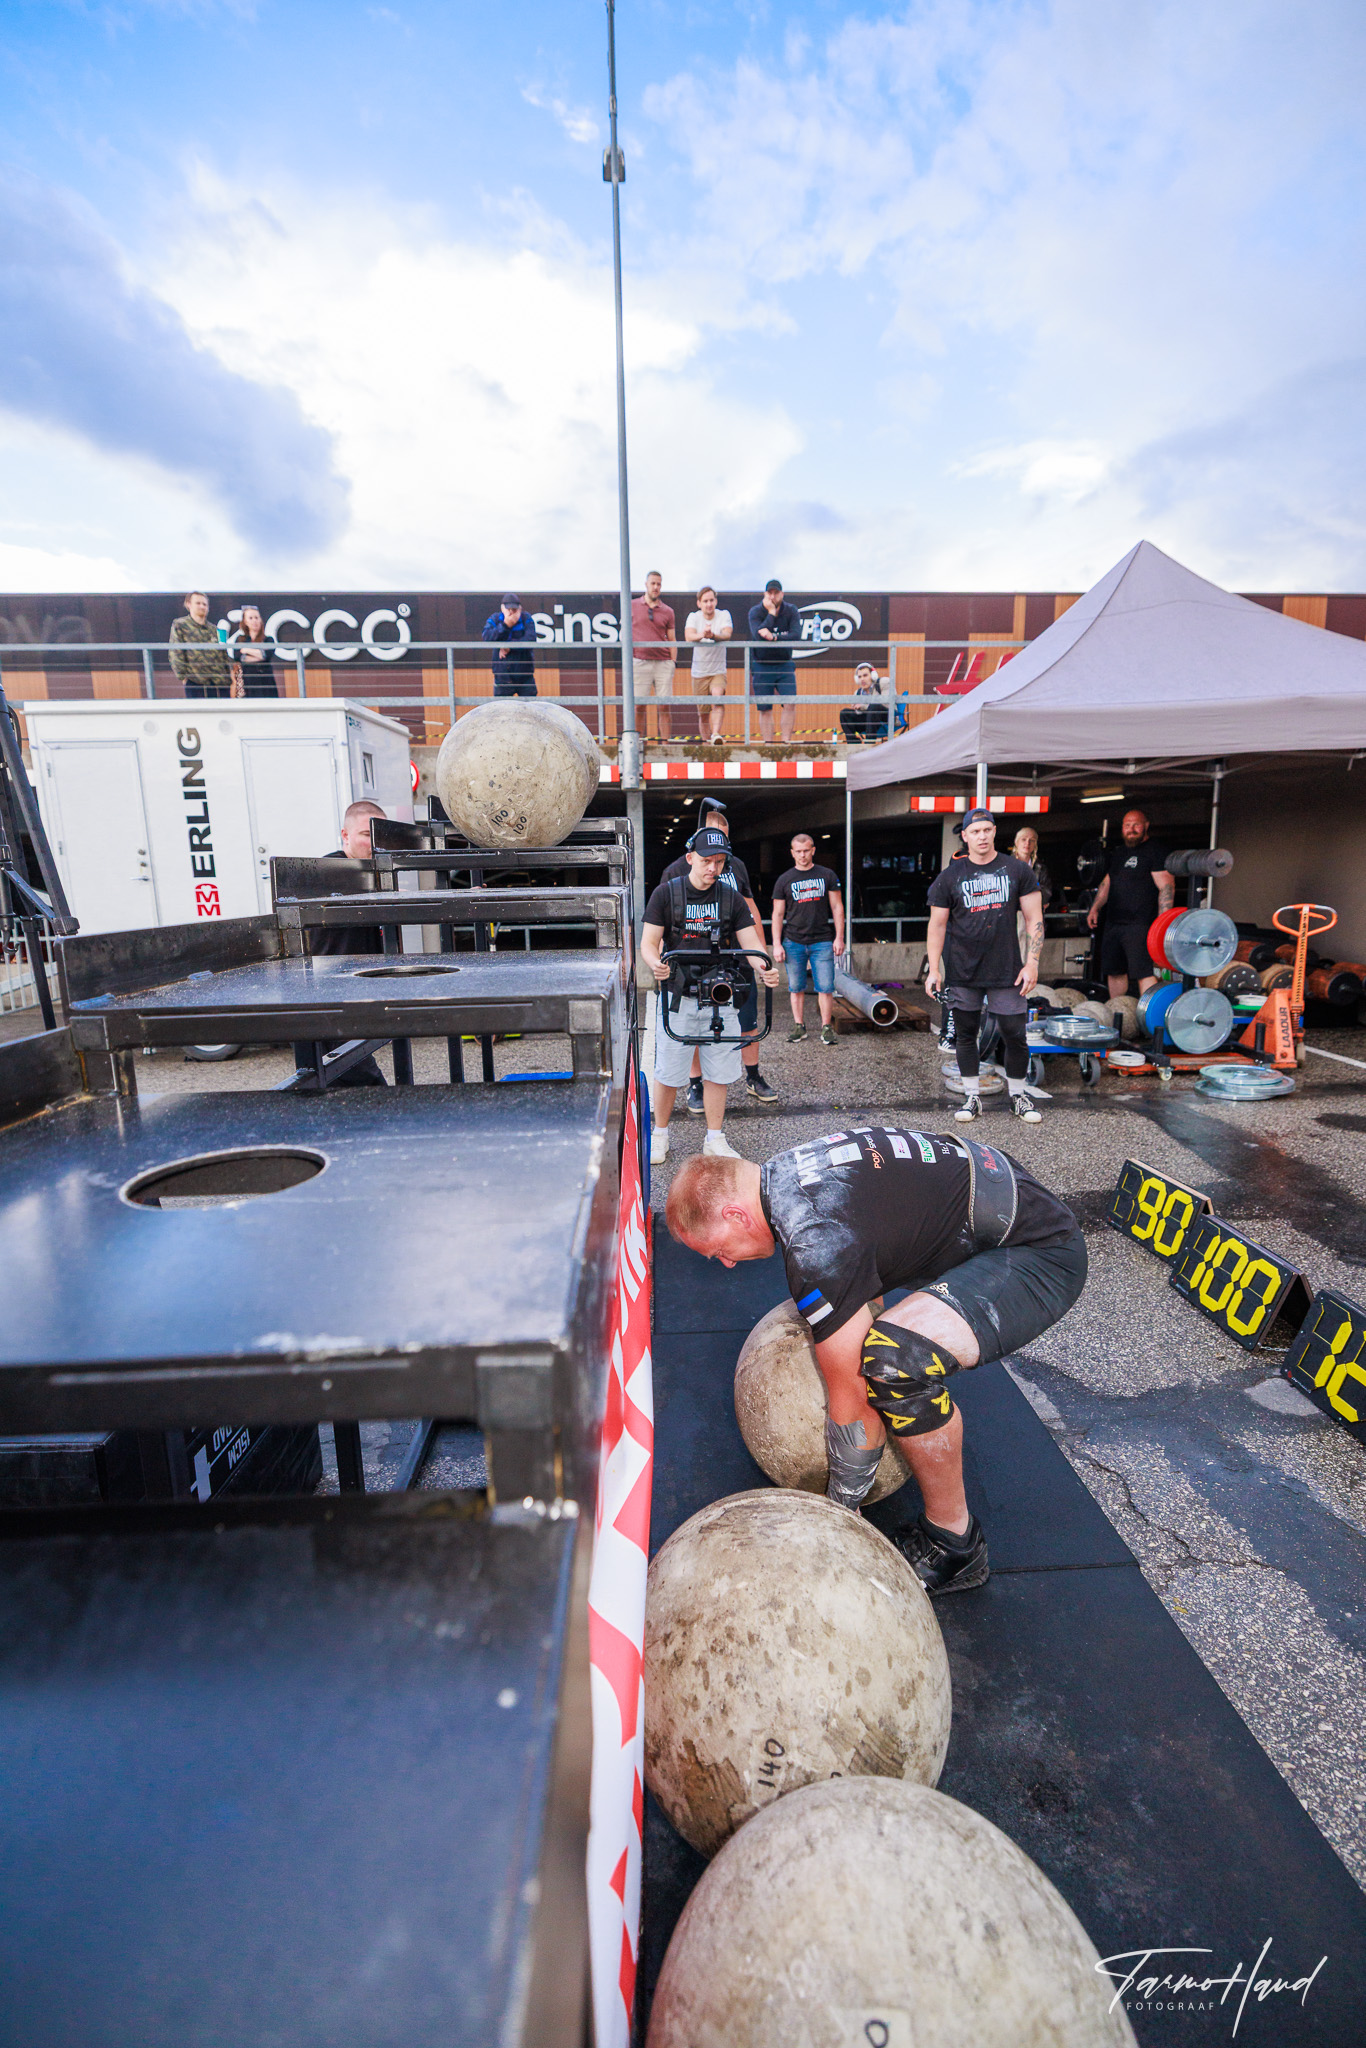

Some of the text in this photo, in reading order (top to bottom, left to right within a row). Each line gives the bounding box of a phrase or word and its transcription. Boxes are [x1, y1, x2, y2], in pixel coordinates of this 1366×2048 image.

[531, 604, 622, 643] sins
[176, 727, 216, 878] ERLING
[491, 810, 508, 828] 100
[513, 816, 527, 835] 100
[872, 1152, 882, 1169] POP
[1131, 1177, 1194, 1257] 90
[1190, 1234, 1282, 1336] 100
[757, 1738, 785, 1788] 140
